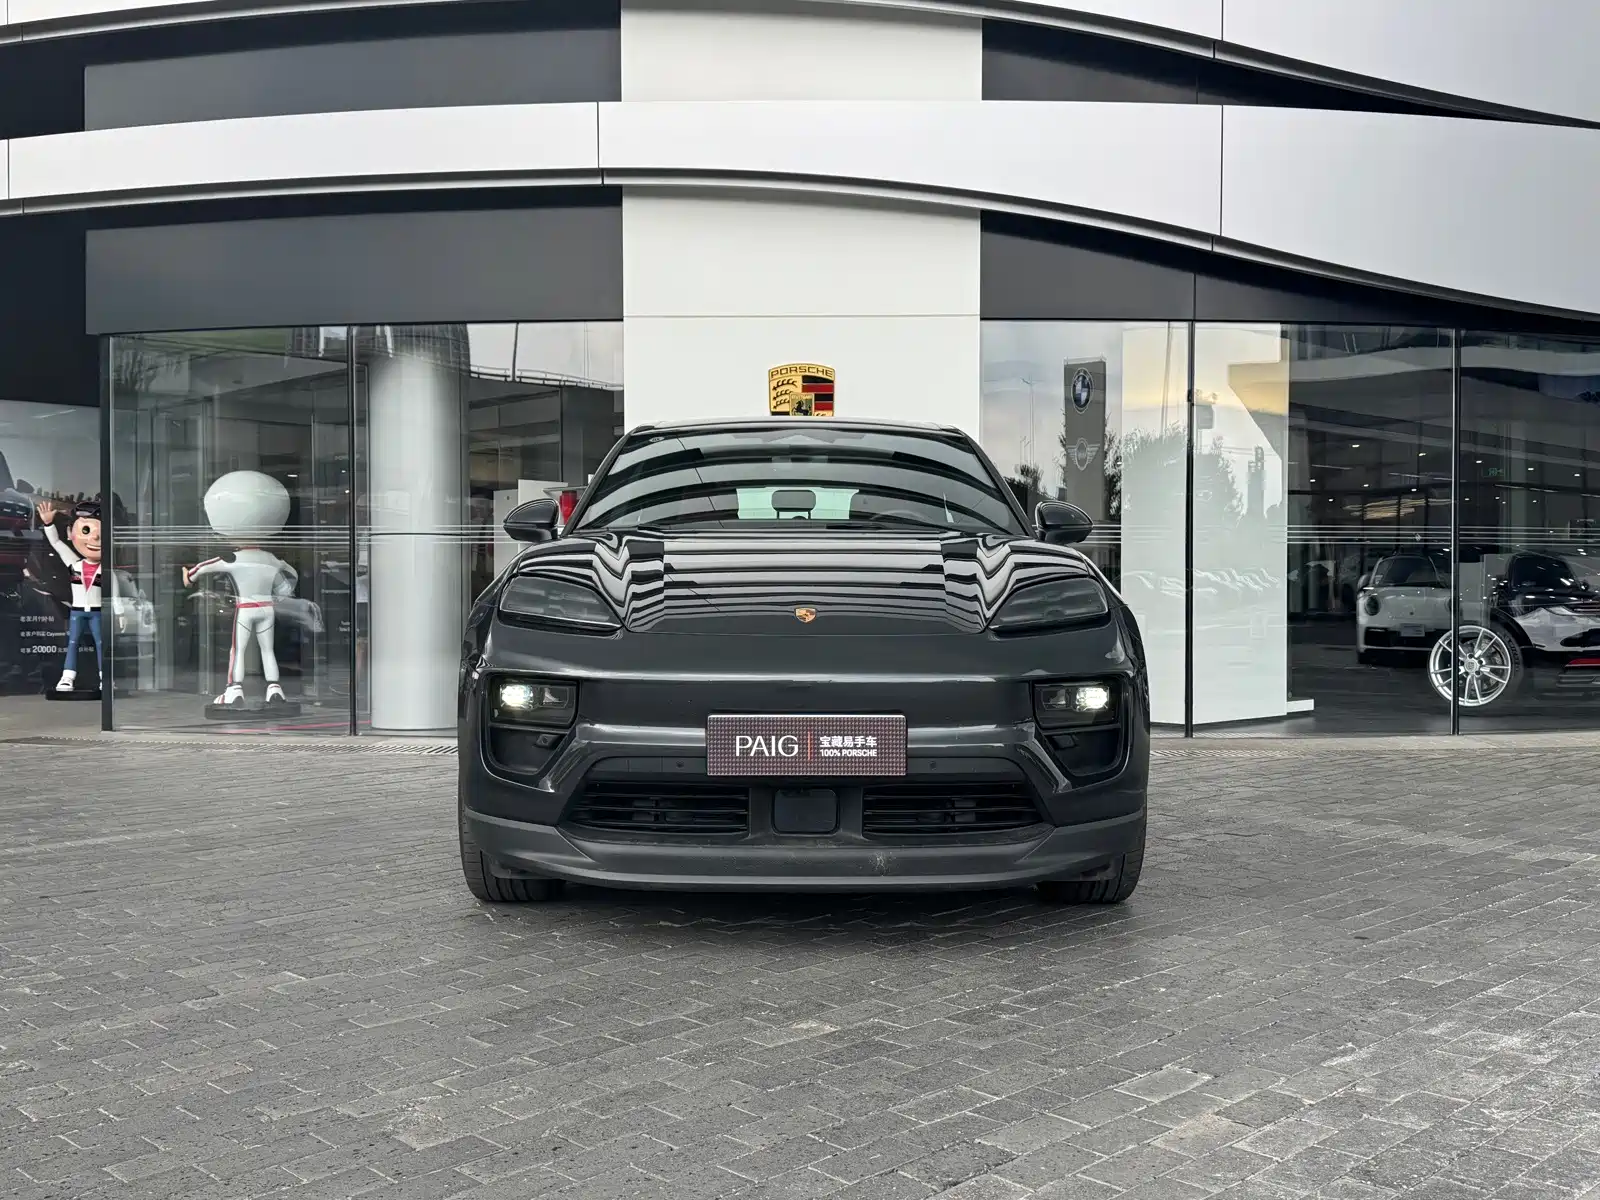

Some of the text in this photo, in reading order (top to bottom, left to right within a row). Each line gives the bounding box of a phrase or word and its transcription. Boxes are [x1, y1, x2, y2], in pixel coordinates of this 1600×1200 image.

[770, 366, 833, 379] PORSCHE
[32, 645, 57, 653] 20000
[735, 735, 799, 757] PAIG
[819, 735, 878, 748] 宝藏易手车
[819, 749, 878, 757] 100% PORSCHE
